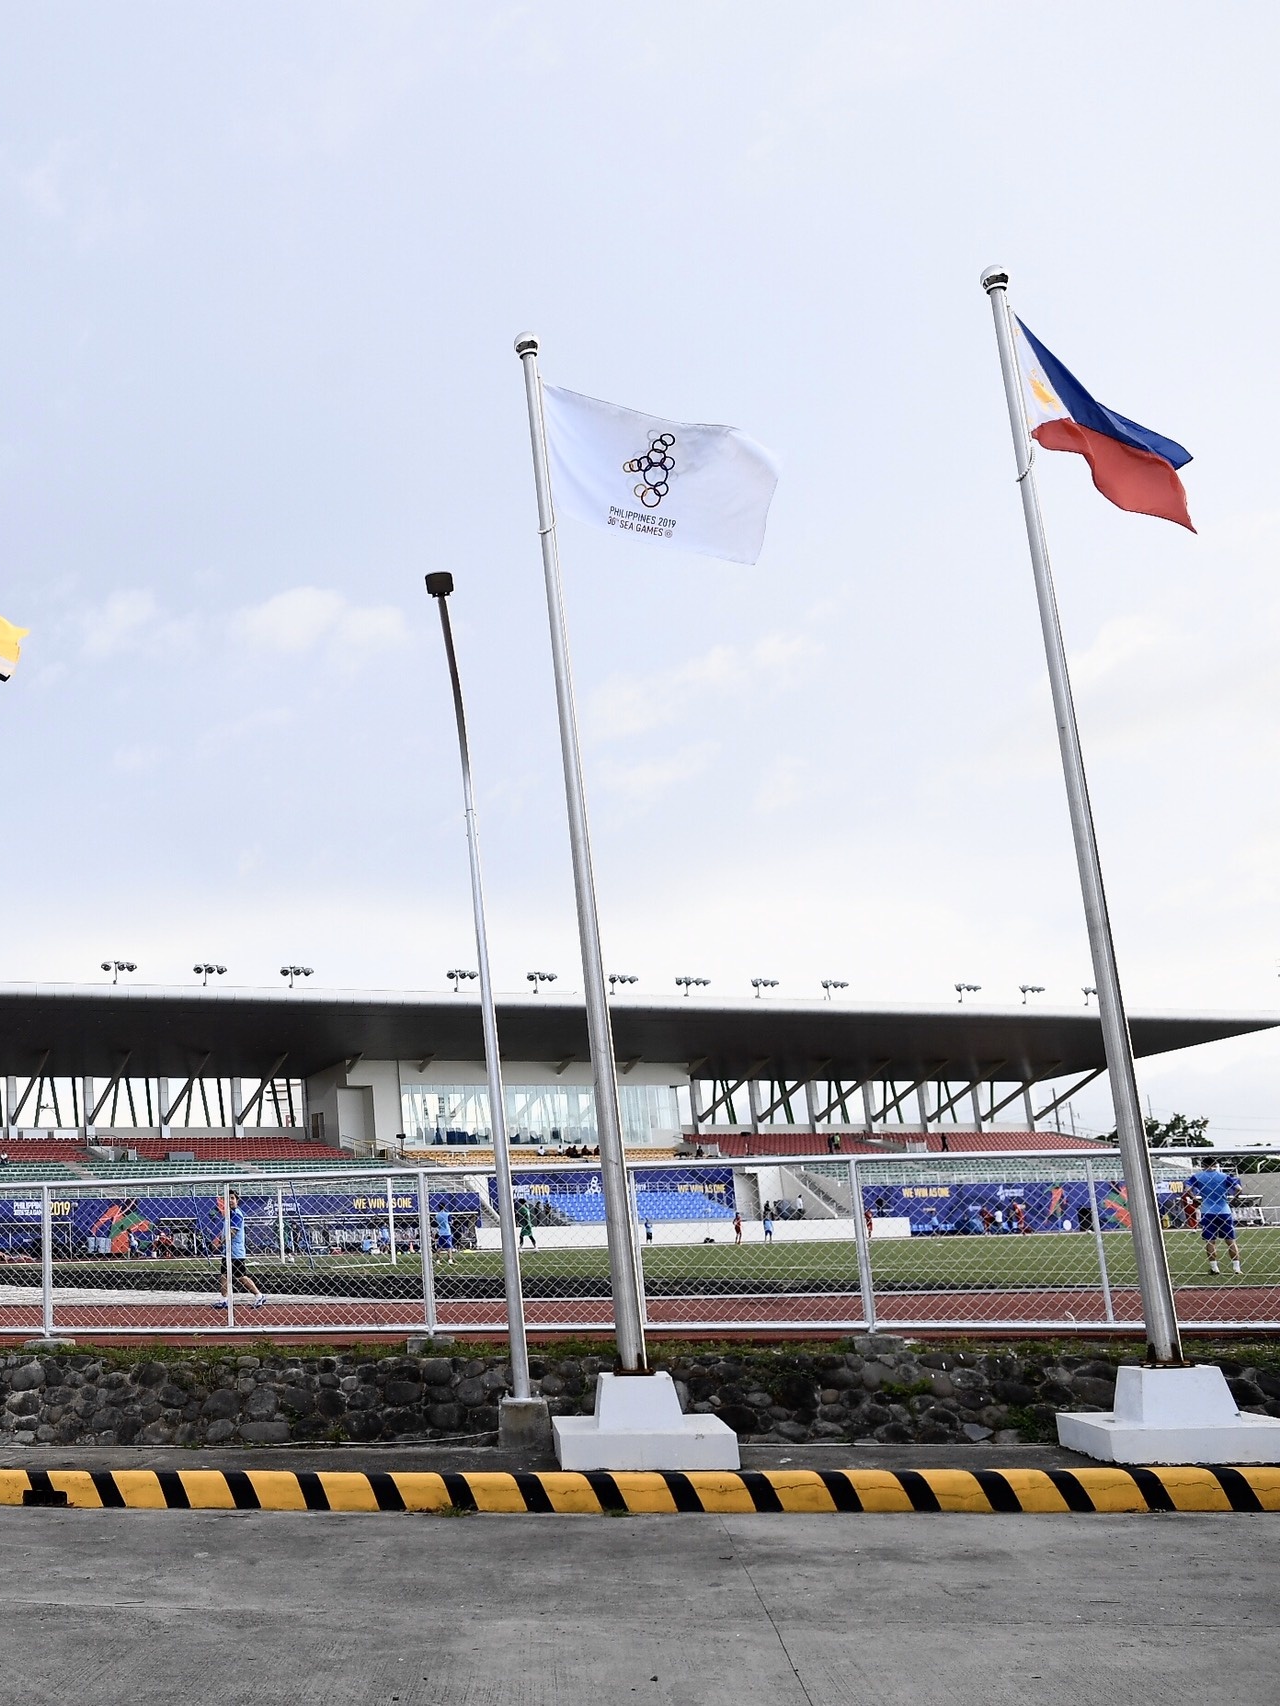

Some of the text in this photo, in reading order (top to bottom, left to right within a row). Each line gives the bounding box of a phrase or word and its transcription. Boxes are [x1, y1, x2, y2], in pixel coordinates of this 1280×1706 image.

[609, 505, 677, 529] PHILIPPINES 2019
[620, 519, 634, 531] SEA
[635, 523, 663, 537] GAMES
[13, 1200, 71, 1216] PHILIPPIN 2019
[352, 1198, 367, 1209] WE
[368, 1198, 385, 1209] WIN
[397, 1197, 413, 1208] ONE
